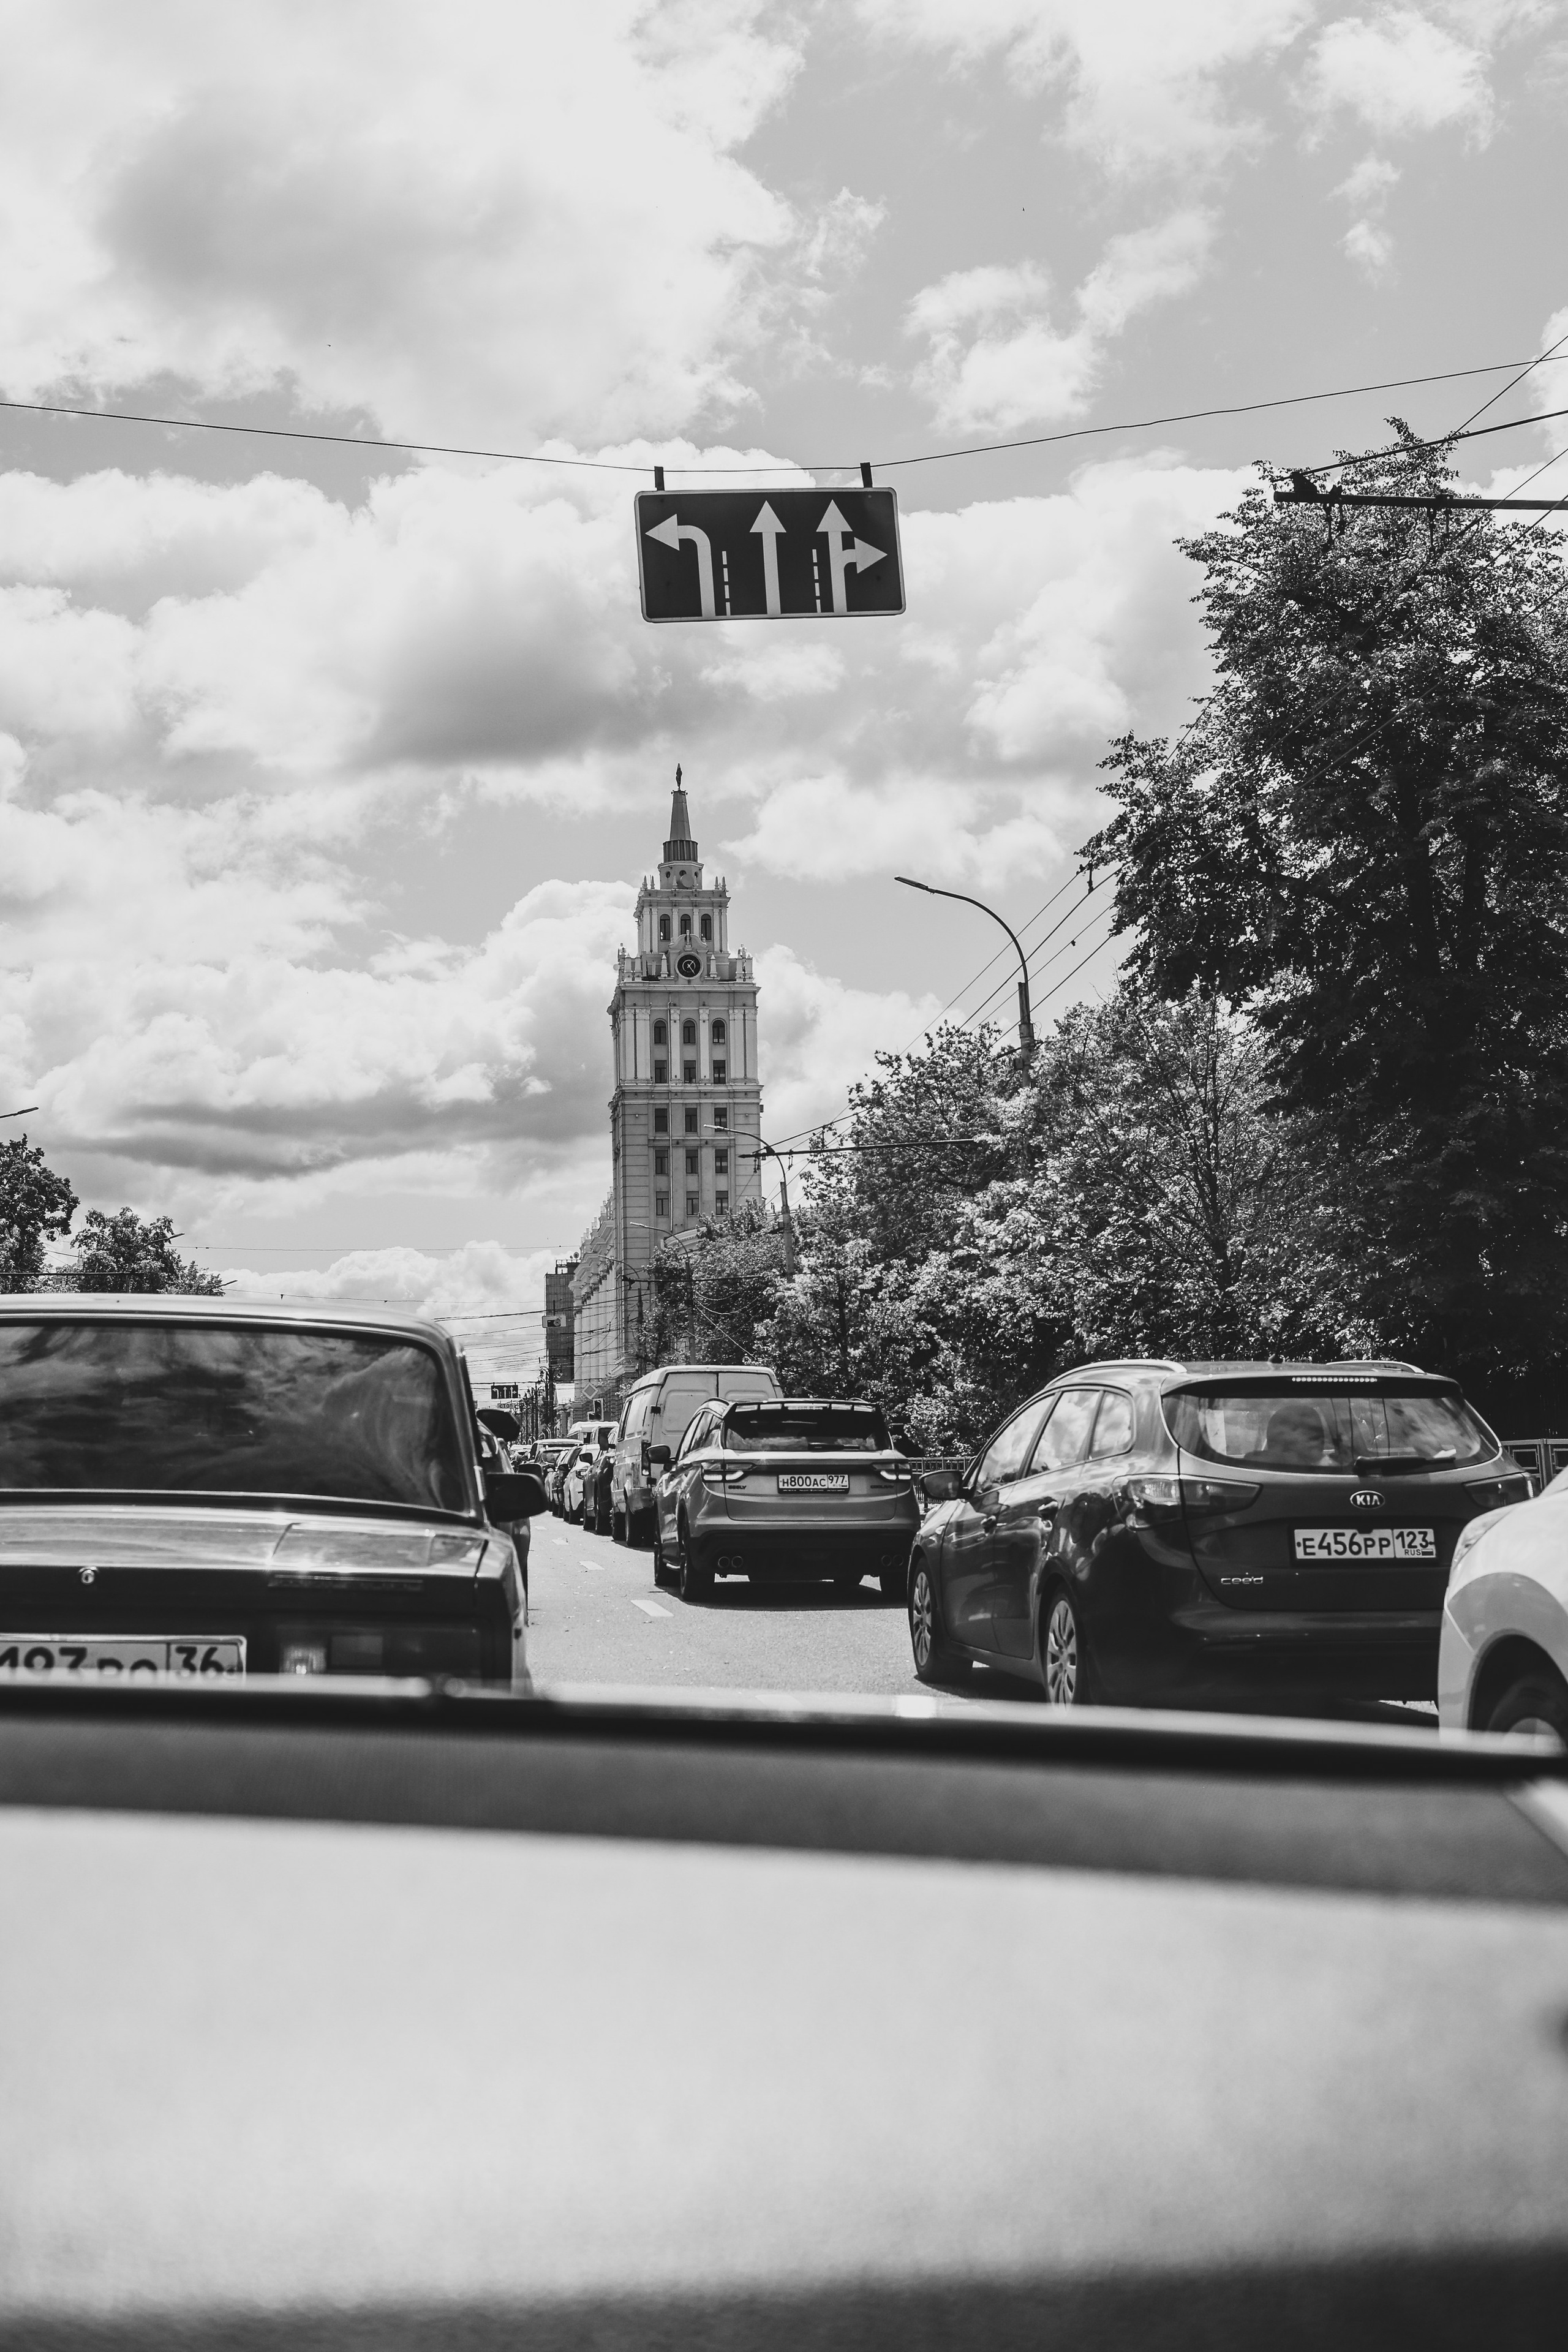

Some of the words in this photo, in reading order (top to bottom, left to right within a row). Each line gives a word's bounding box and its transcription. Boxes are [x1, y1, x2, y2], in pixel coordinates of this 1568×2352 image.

[828, 1475, 845, 1483] 977
[1356, 1495, 1380, 1505] KIA
[1395, 1531, 1429, 1548] 123
